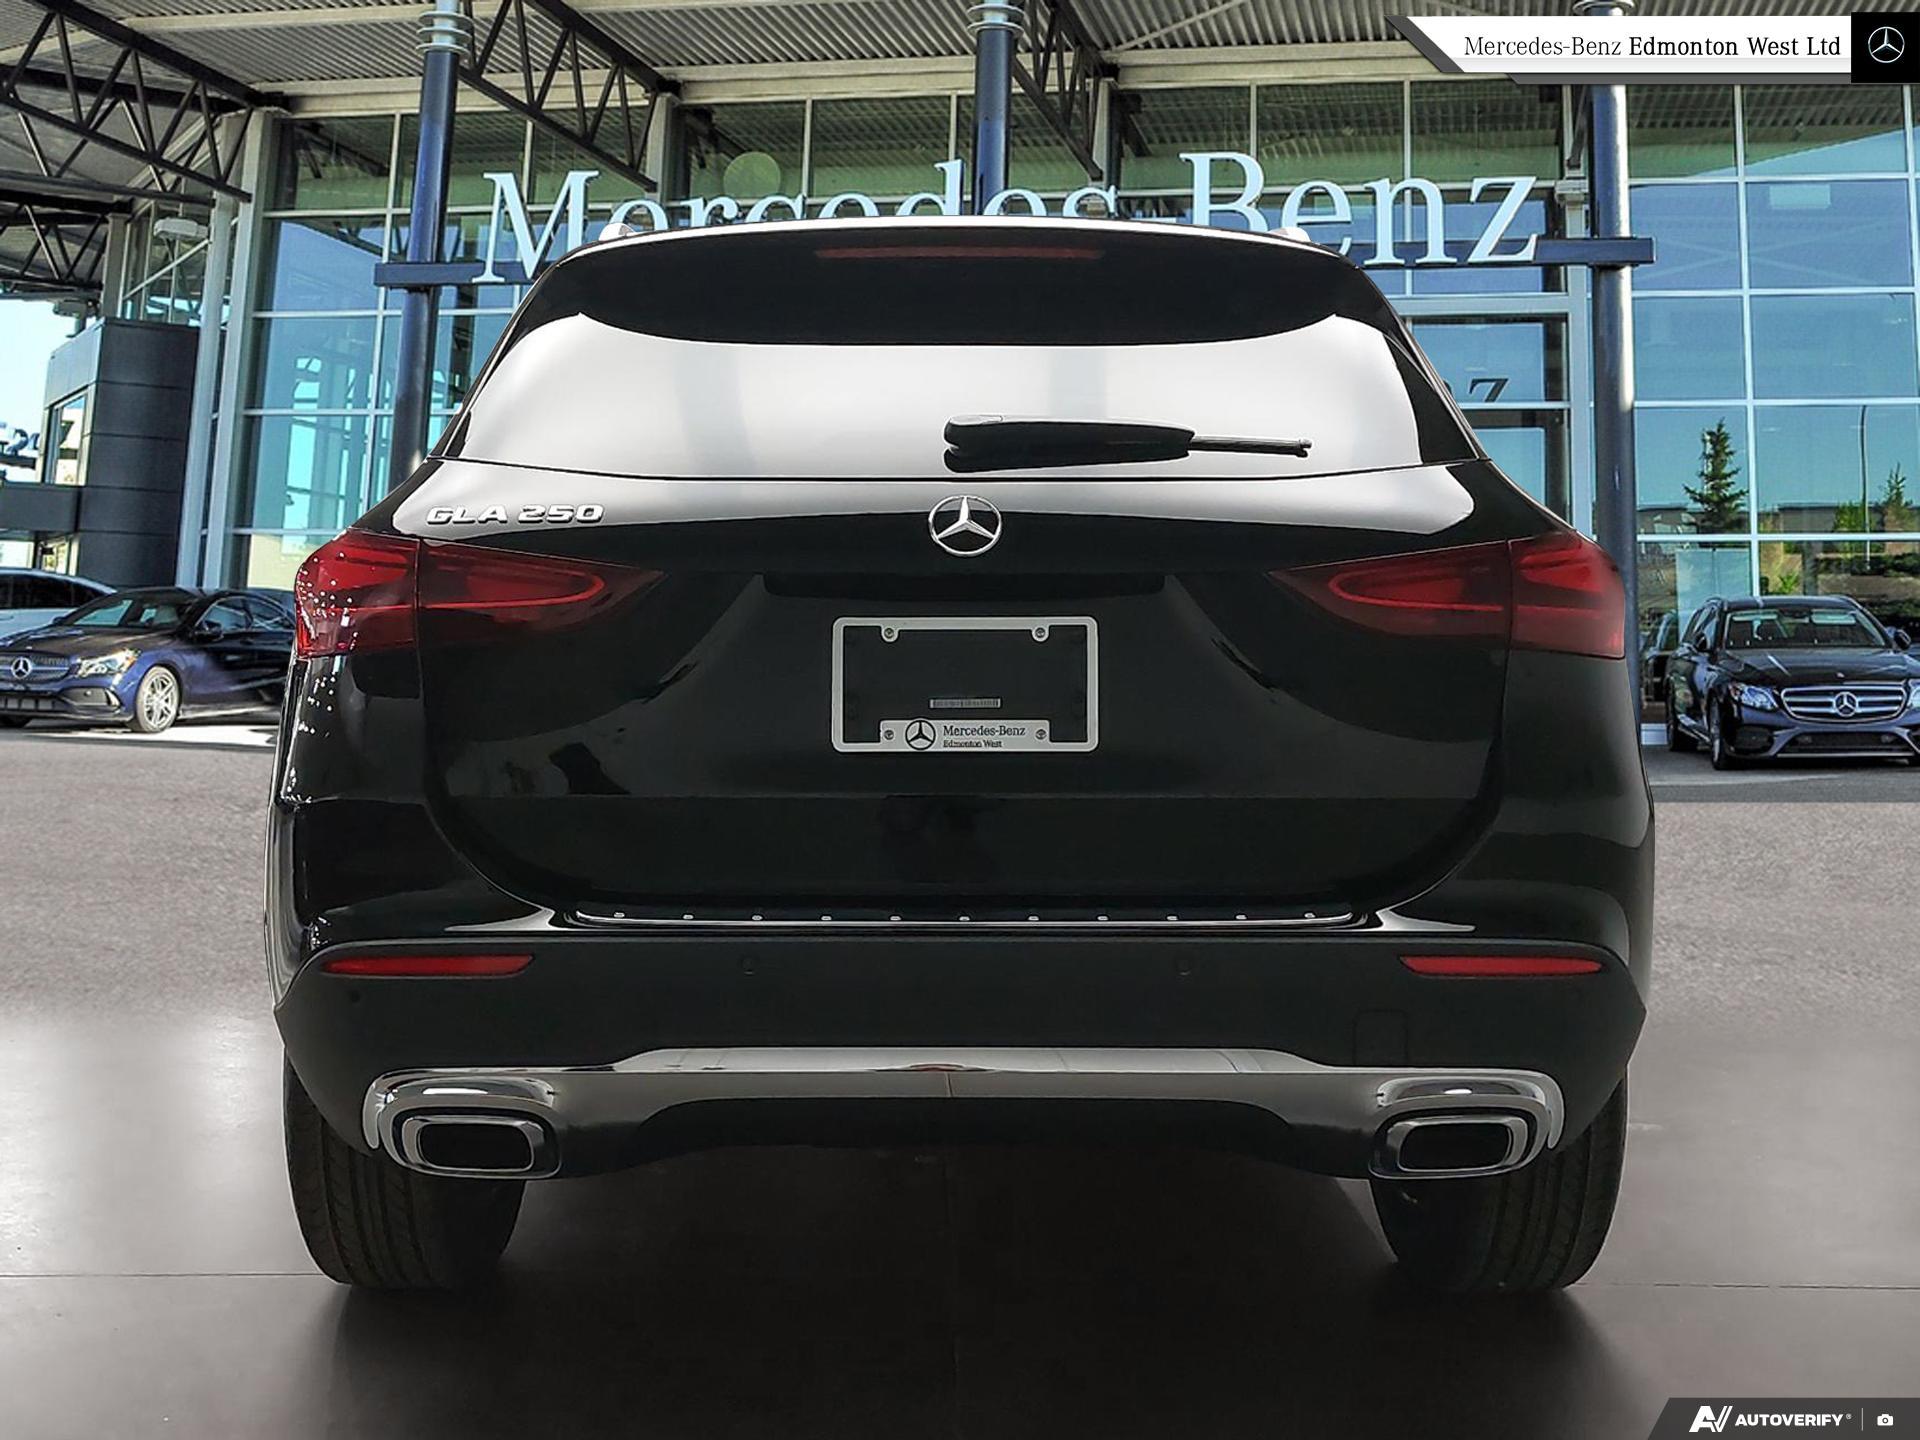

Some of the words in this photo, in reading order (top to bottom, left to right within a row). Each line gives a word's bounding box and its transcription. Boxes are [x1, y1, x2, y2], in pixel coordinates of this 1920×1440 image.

[426, 505, 508, 525] GLA
[517, 504, 605, 524] 250
[943, 725, 1026, 736] Mercedes-Benz
